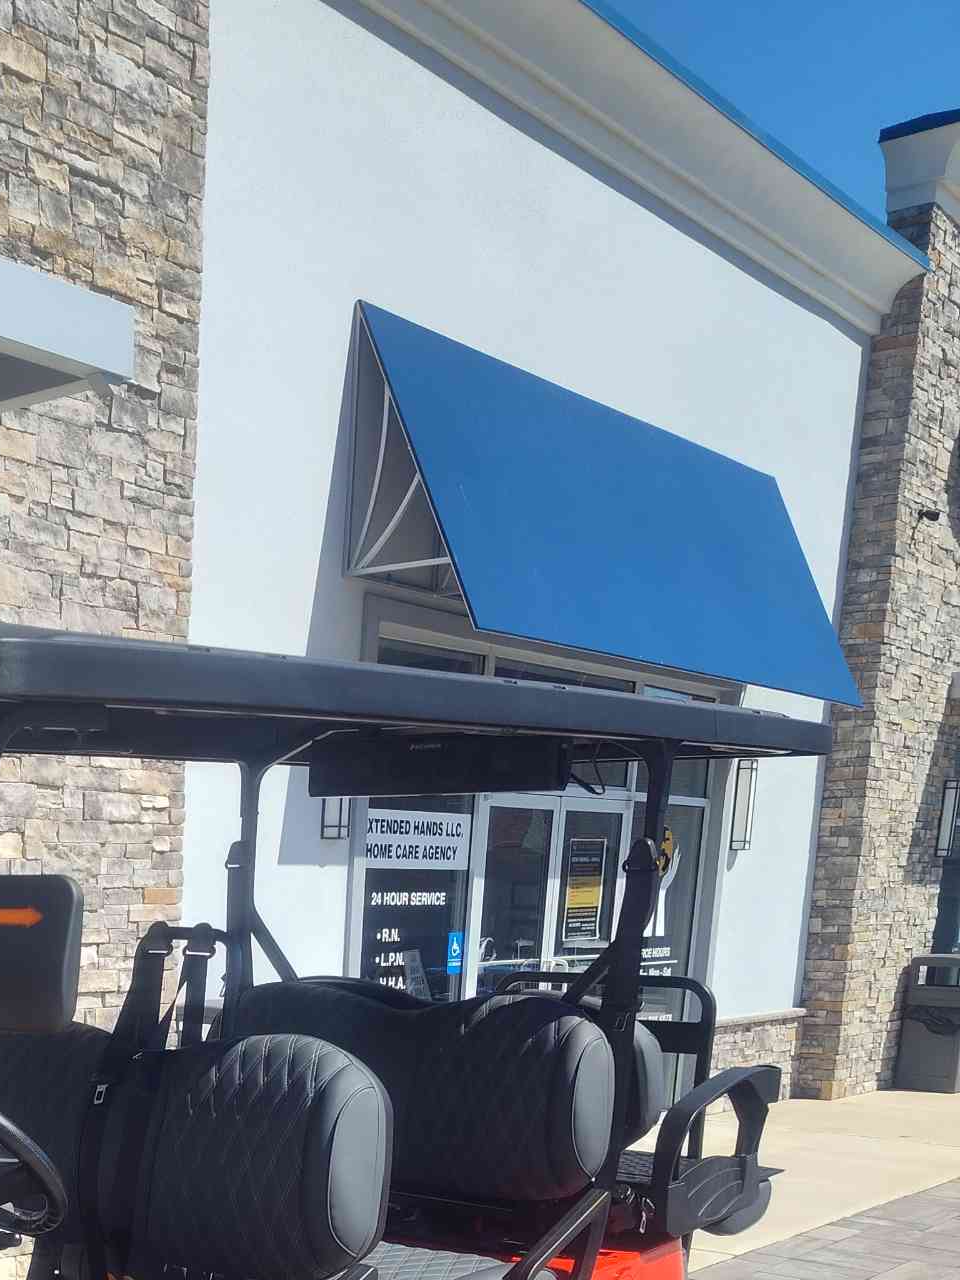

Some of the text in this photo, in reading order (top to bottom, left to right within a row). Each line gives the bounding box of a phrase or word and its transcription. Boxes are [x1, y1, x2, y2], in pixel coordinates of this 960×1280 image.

[367, 818, 411, 835] XTENDED
[413, 821, 443, 837] HANDS
[366, 843, 458, 861] HOME CARE AGENCY
[371, 892, 446, 906] 24 HOUR SERVICE
